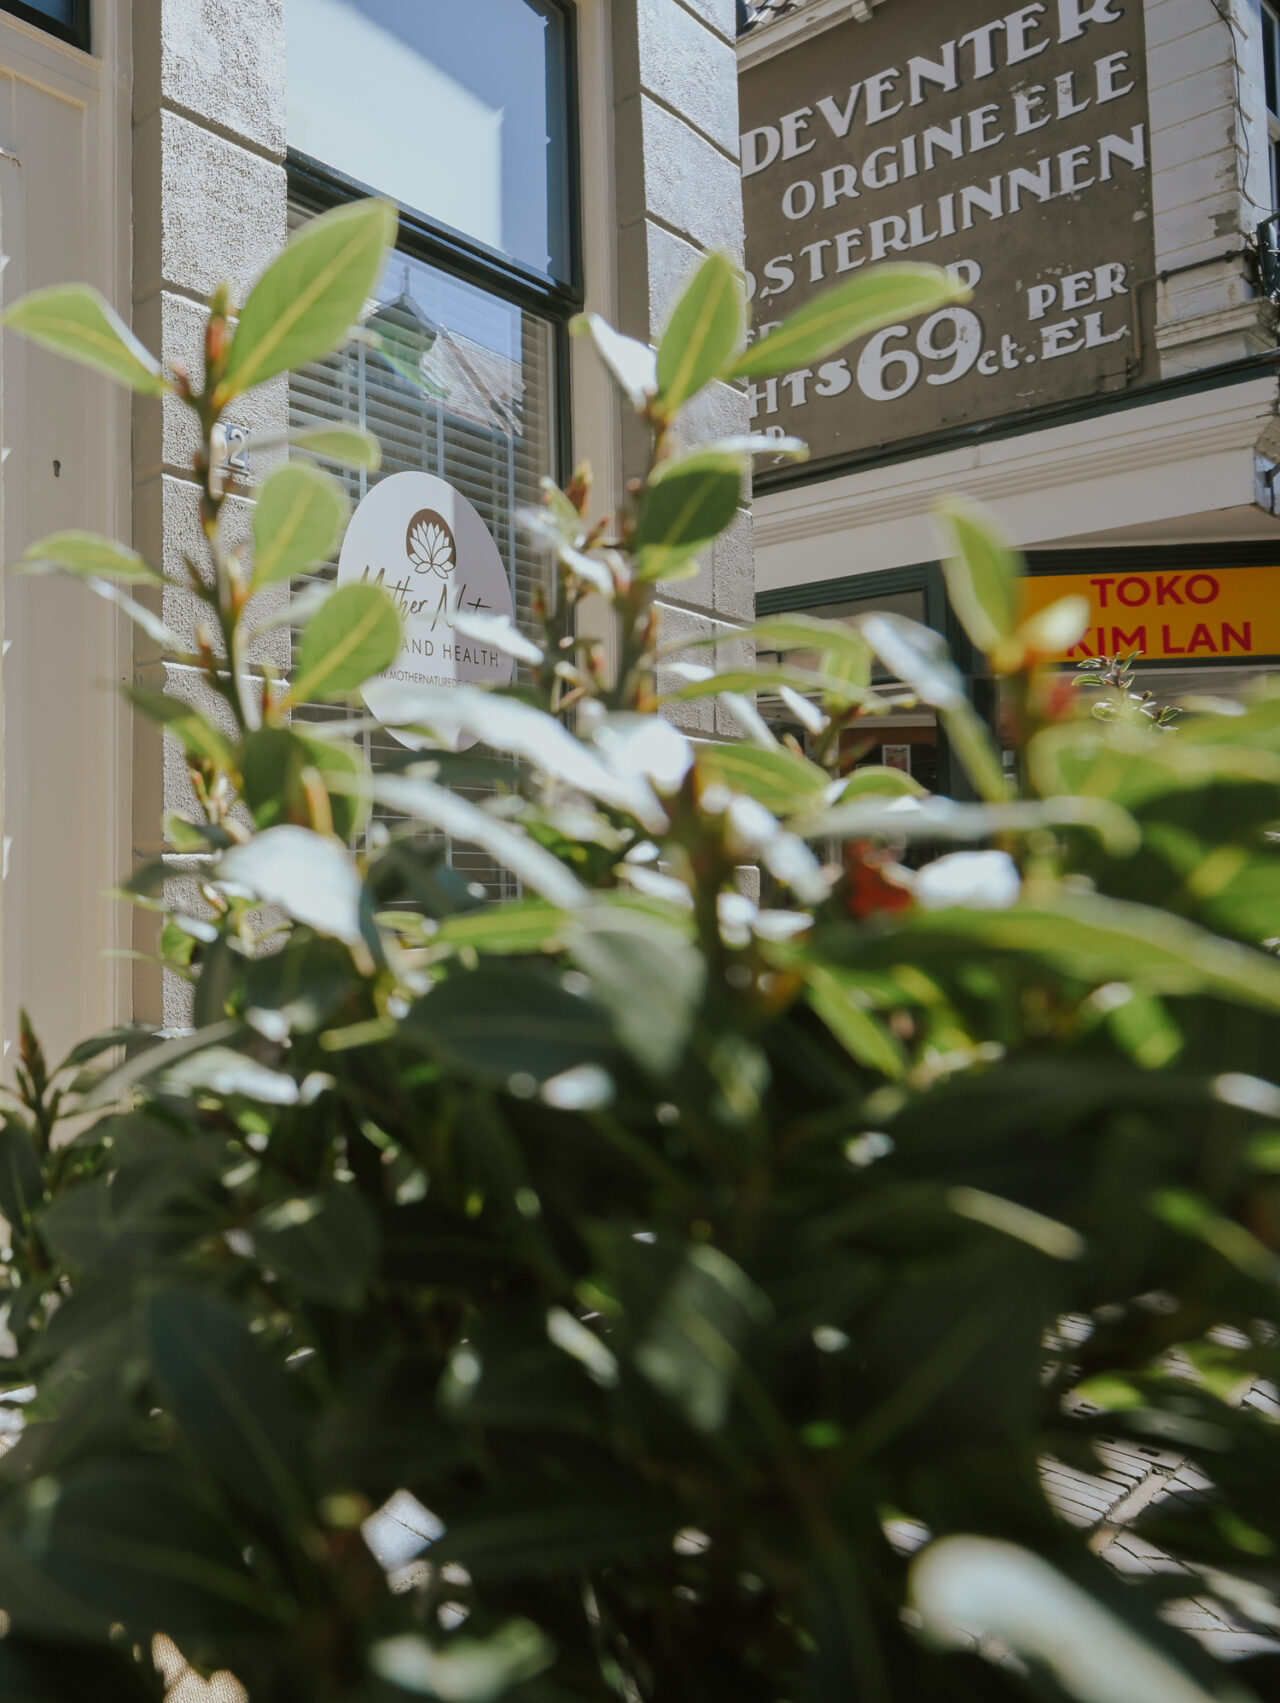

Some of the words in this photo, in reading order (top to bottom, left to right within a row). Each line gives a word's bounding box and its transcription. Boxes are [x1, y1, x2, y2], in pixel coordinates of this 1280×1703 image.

[739, 0, 1122, 178] DEVENTER
[782, 51, 1135, 220] ORGINEELE
[1027, 263, 1129, 320] PER
[1040, 312, 1131, 360] EL
[361, 565, 428, 622] ther
[1090, 574, 1220, 608] TOKO
[401, 637, 434, 656] AND
[443, 643, 498, 667] HEALTH
[1067, 625, 1147, 657] KIM
[1162, 622, 1252, 654] LAN
